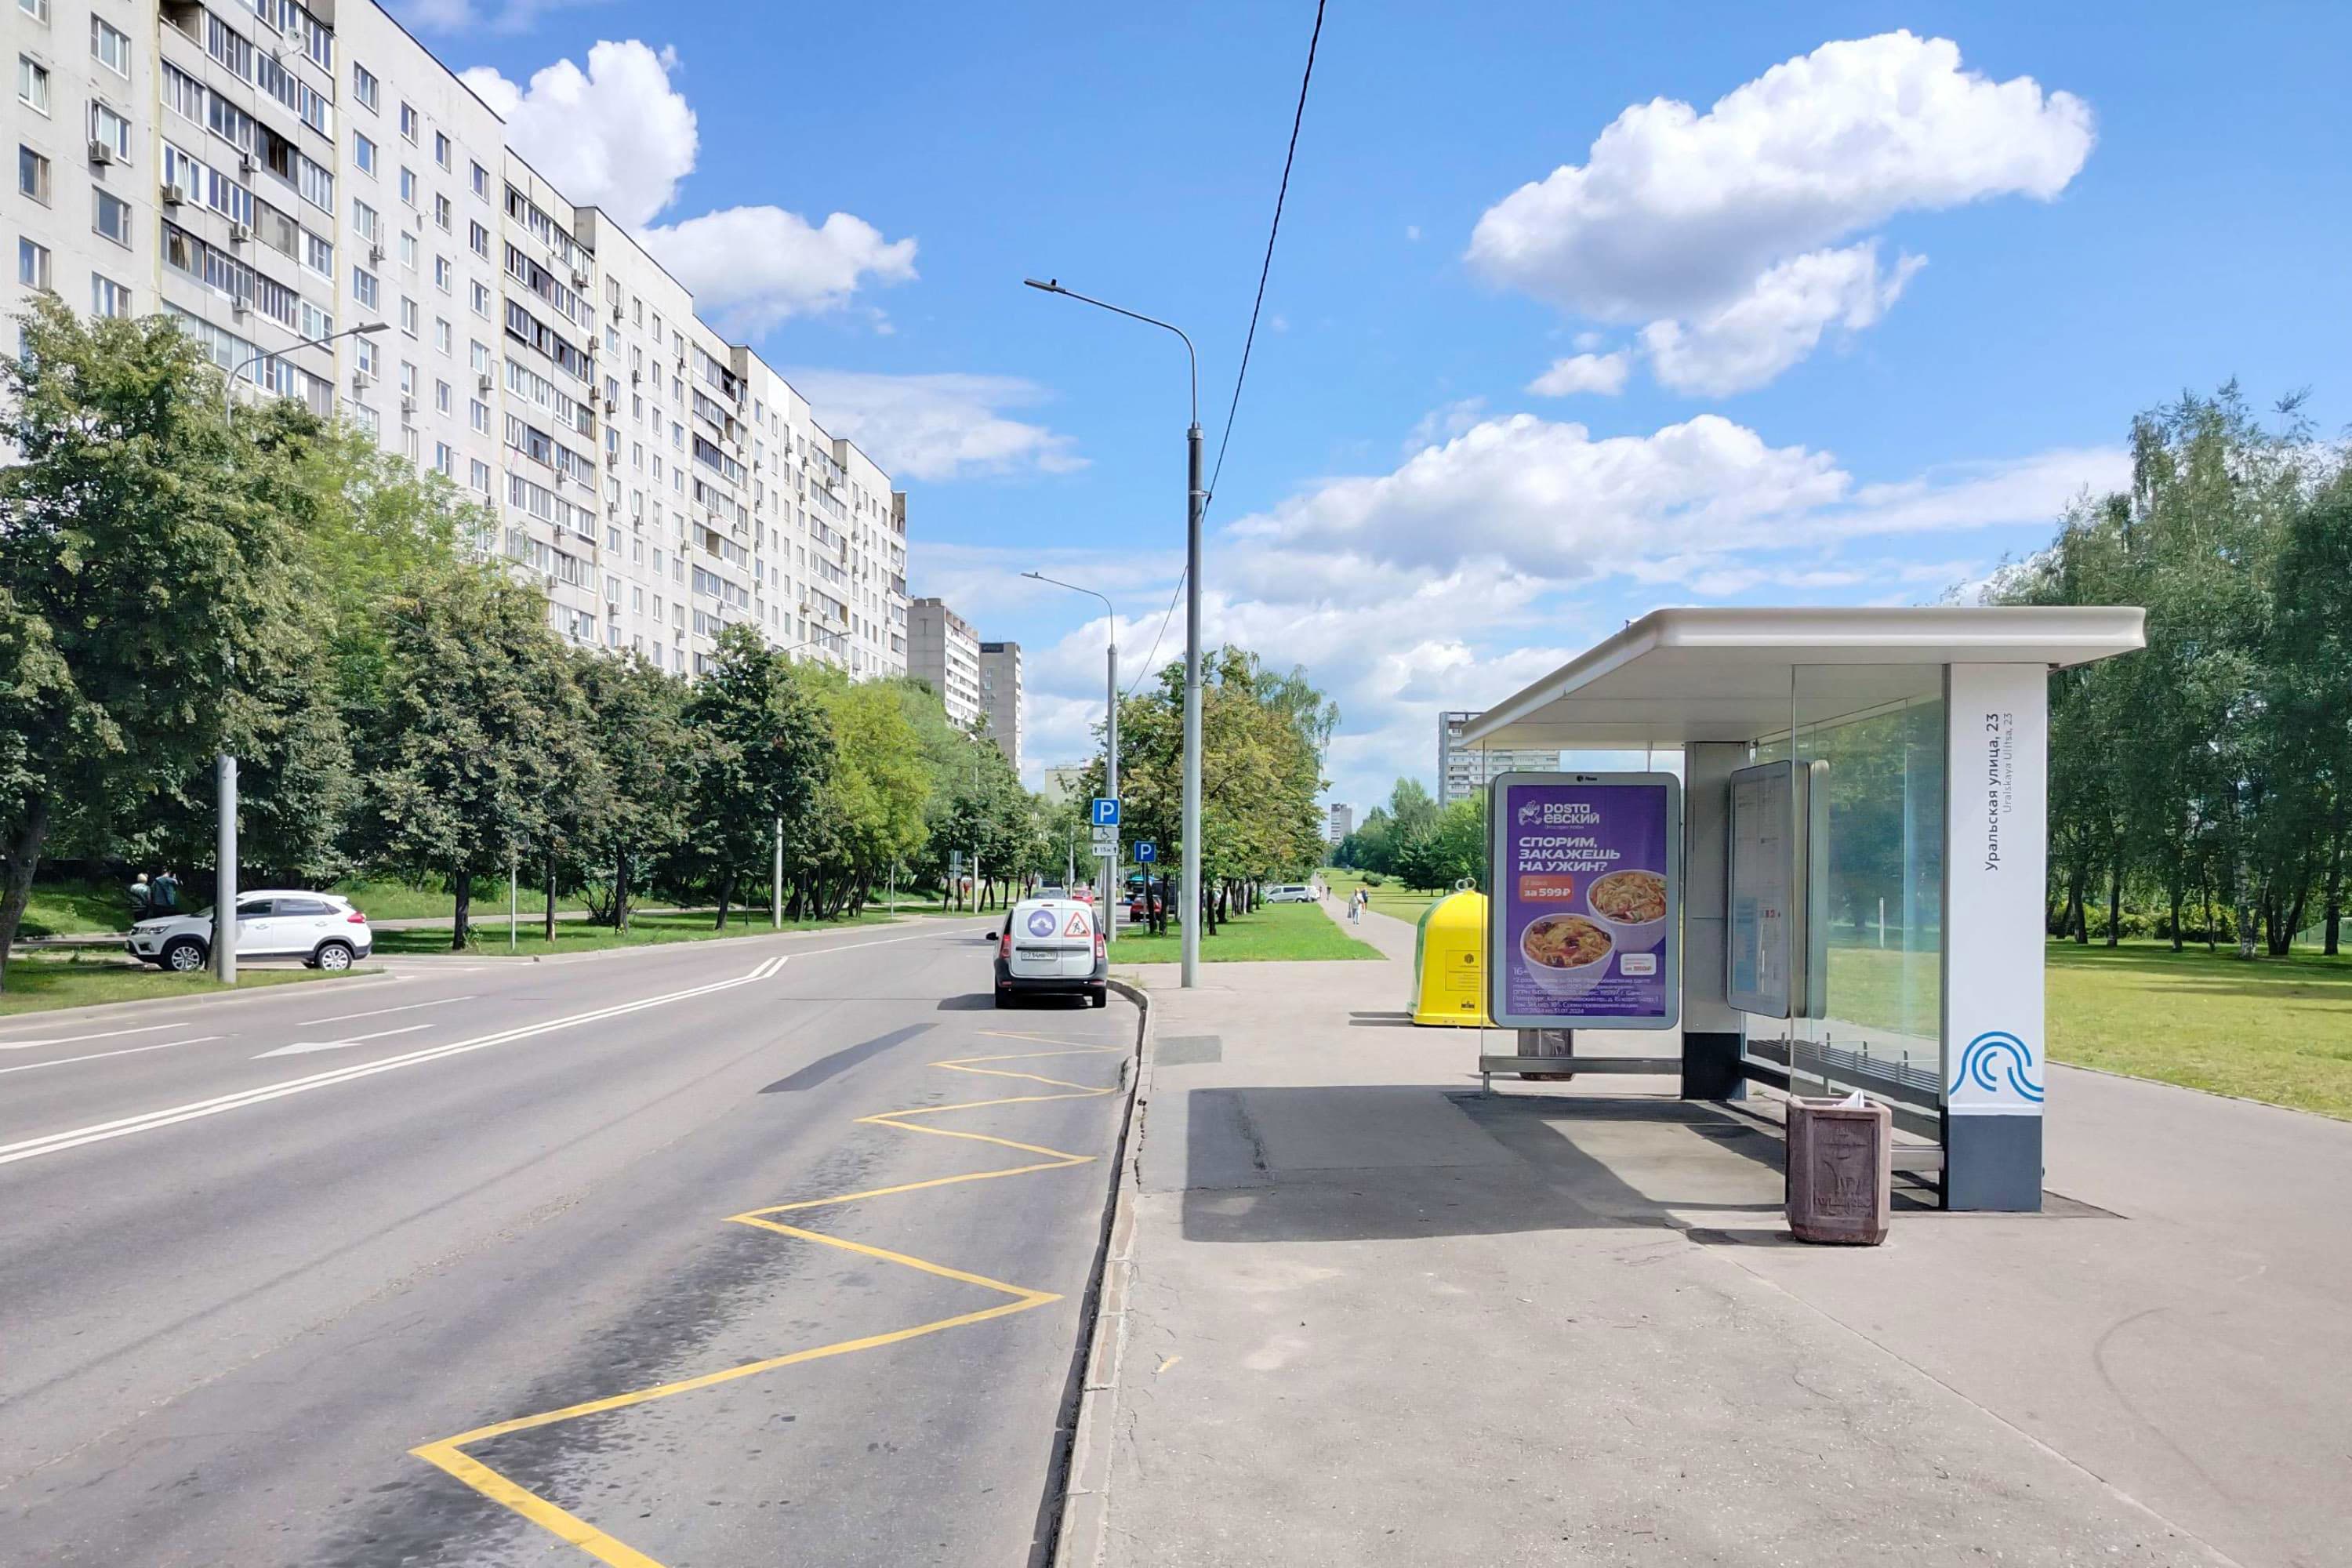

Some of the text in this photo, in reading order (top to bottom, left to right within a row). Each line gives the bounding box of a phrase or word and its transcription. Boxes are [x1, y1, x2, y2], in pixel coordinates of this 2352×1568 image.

[2004, 713, 2013, 725] 23
[1985, 713, 2001, 871] Уральская улица, 23
[2003, 763, 2013, 813] Uralskaya
[1100, 801, 1115, 822] P
[1519, 837, 1598, 848] СПОРИМ,
[1141, 844, 1152, 860] P
[1519, 849, 1621, 859] ЗАКАЖЕШЬ
[1519, 861, 1608, 872] НА УЖИН?
